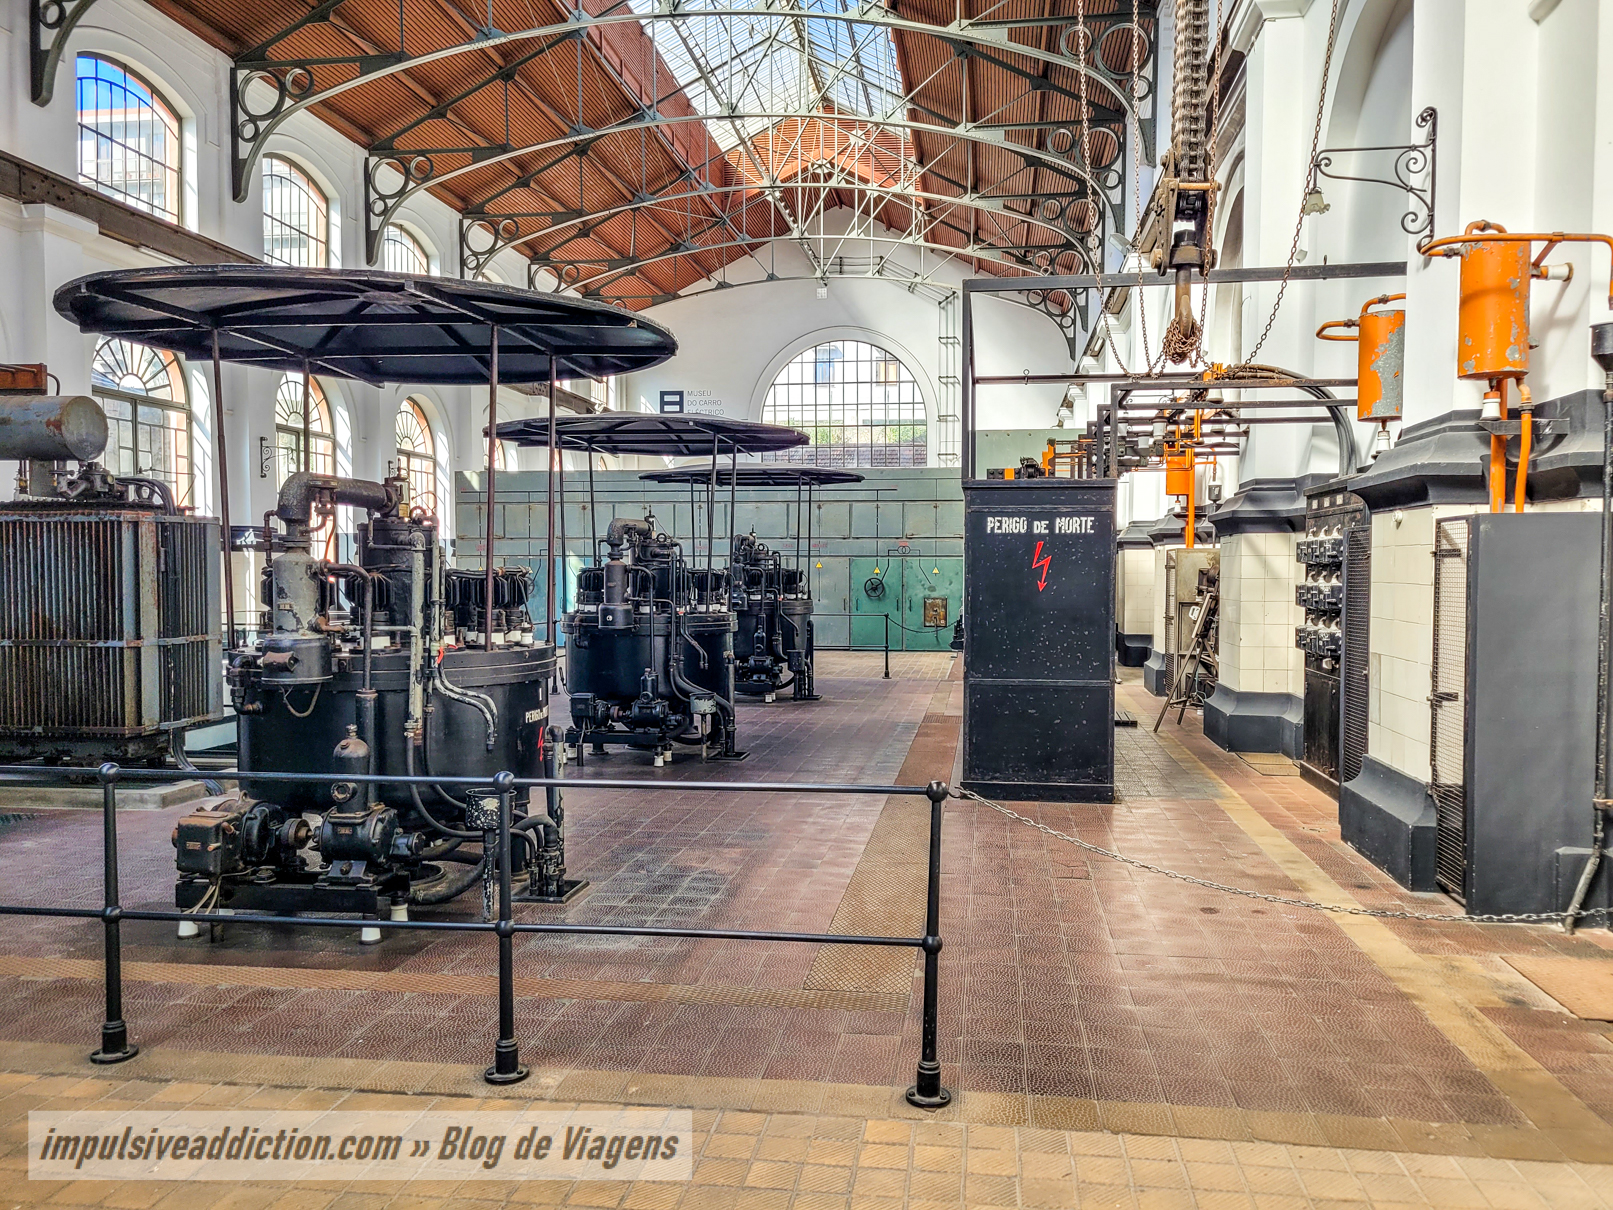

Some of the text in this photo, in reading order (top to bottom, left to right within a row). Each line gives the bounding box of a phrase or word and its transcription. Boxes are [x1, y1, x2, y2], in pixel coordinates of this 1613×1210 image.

[987, 517, 1094, 533] PERIGO DE MORTE
